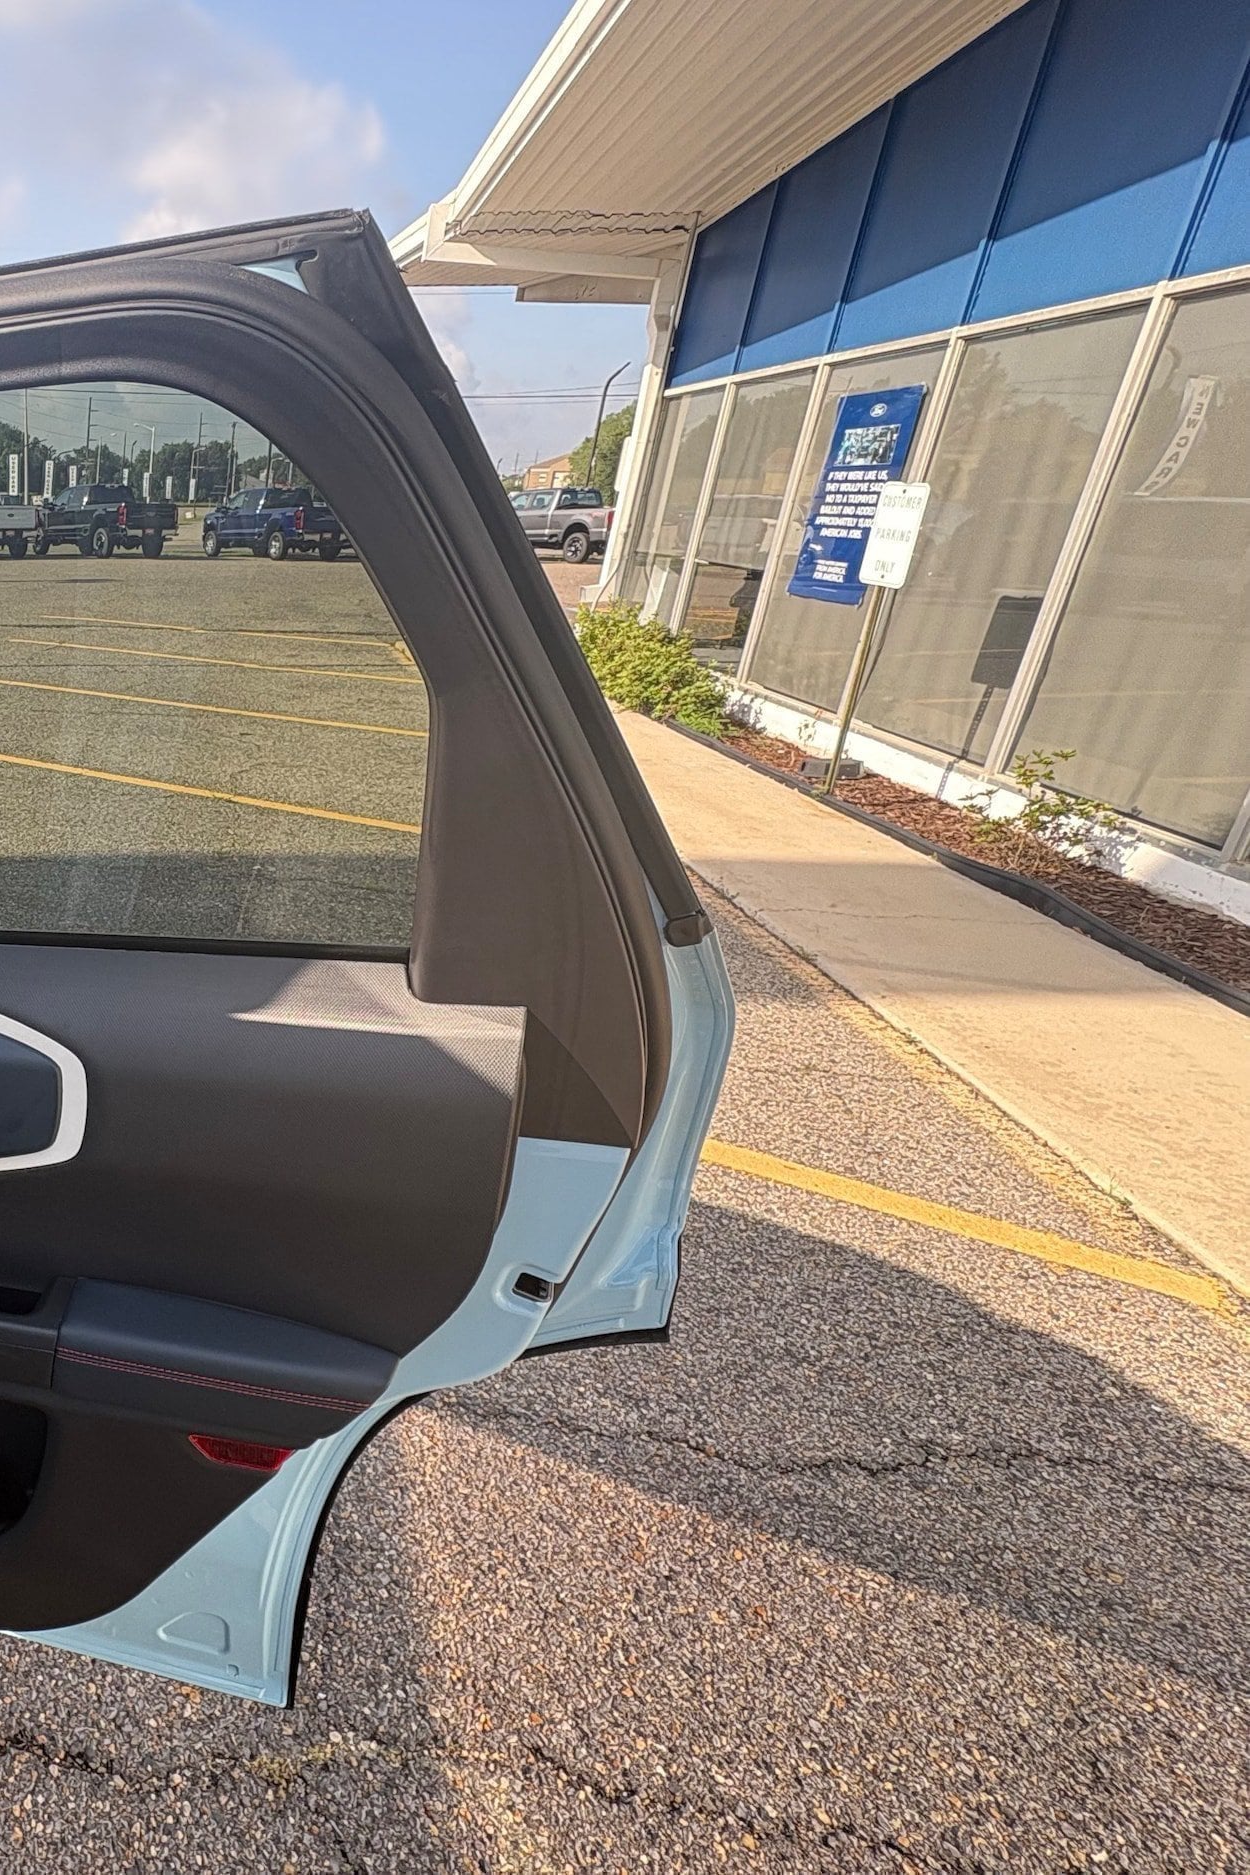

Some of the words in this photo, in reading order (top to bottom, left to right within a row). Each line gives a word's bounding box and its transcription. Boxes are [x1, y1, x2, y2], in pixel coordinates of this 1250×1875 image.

[833, 471, 847, 480] THEY
[847, 471, 863, 480] WERE
[864, 470, 877, 480] LIKE
[825, 483, 839, 492] THEY
[825, 494, 835, 503] NO
[835, 494, 843, 503] TO
[848, 494, 878, 504] TAXPAYER
[883, 495, 923, 509] CUSTOMER
[820, 505, 842, 515] BAILOUT
[842, 506, 855, 515] AND
[855, 506, 876, 516] ADDED
[814, 516, 857, 527] APPROXIMATELY
[820, 528, 848, 537] AMERICAN
[875, 528, 912, 542] PARKING
[875, 560, 895, 573] ONLY
